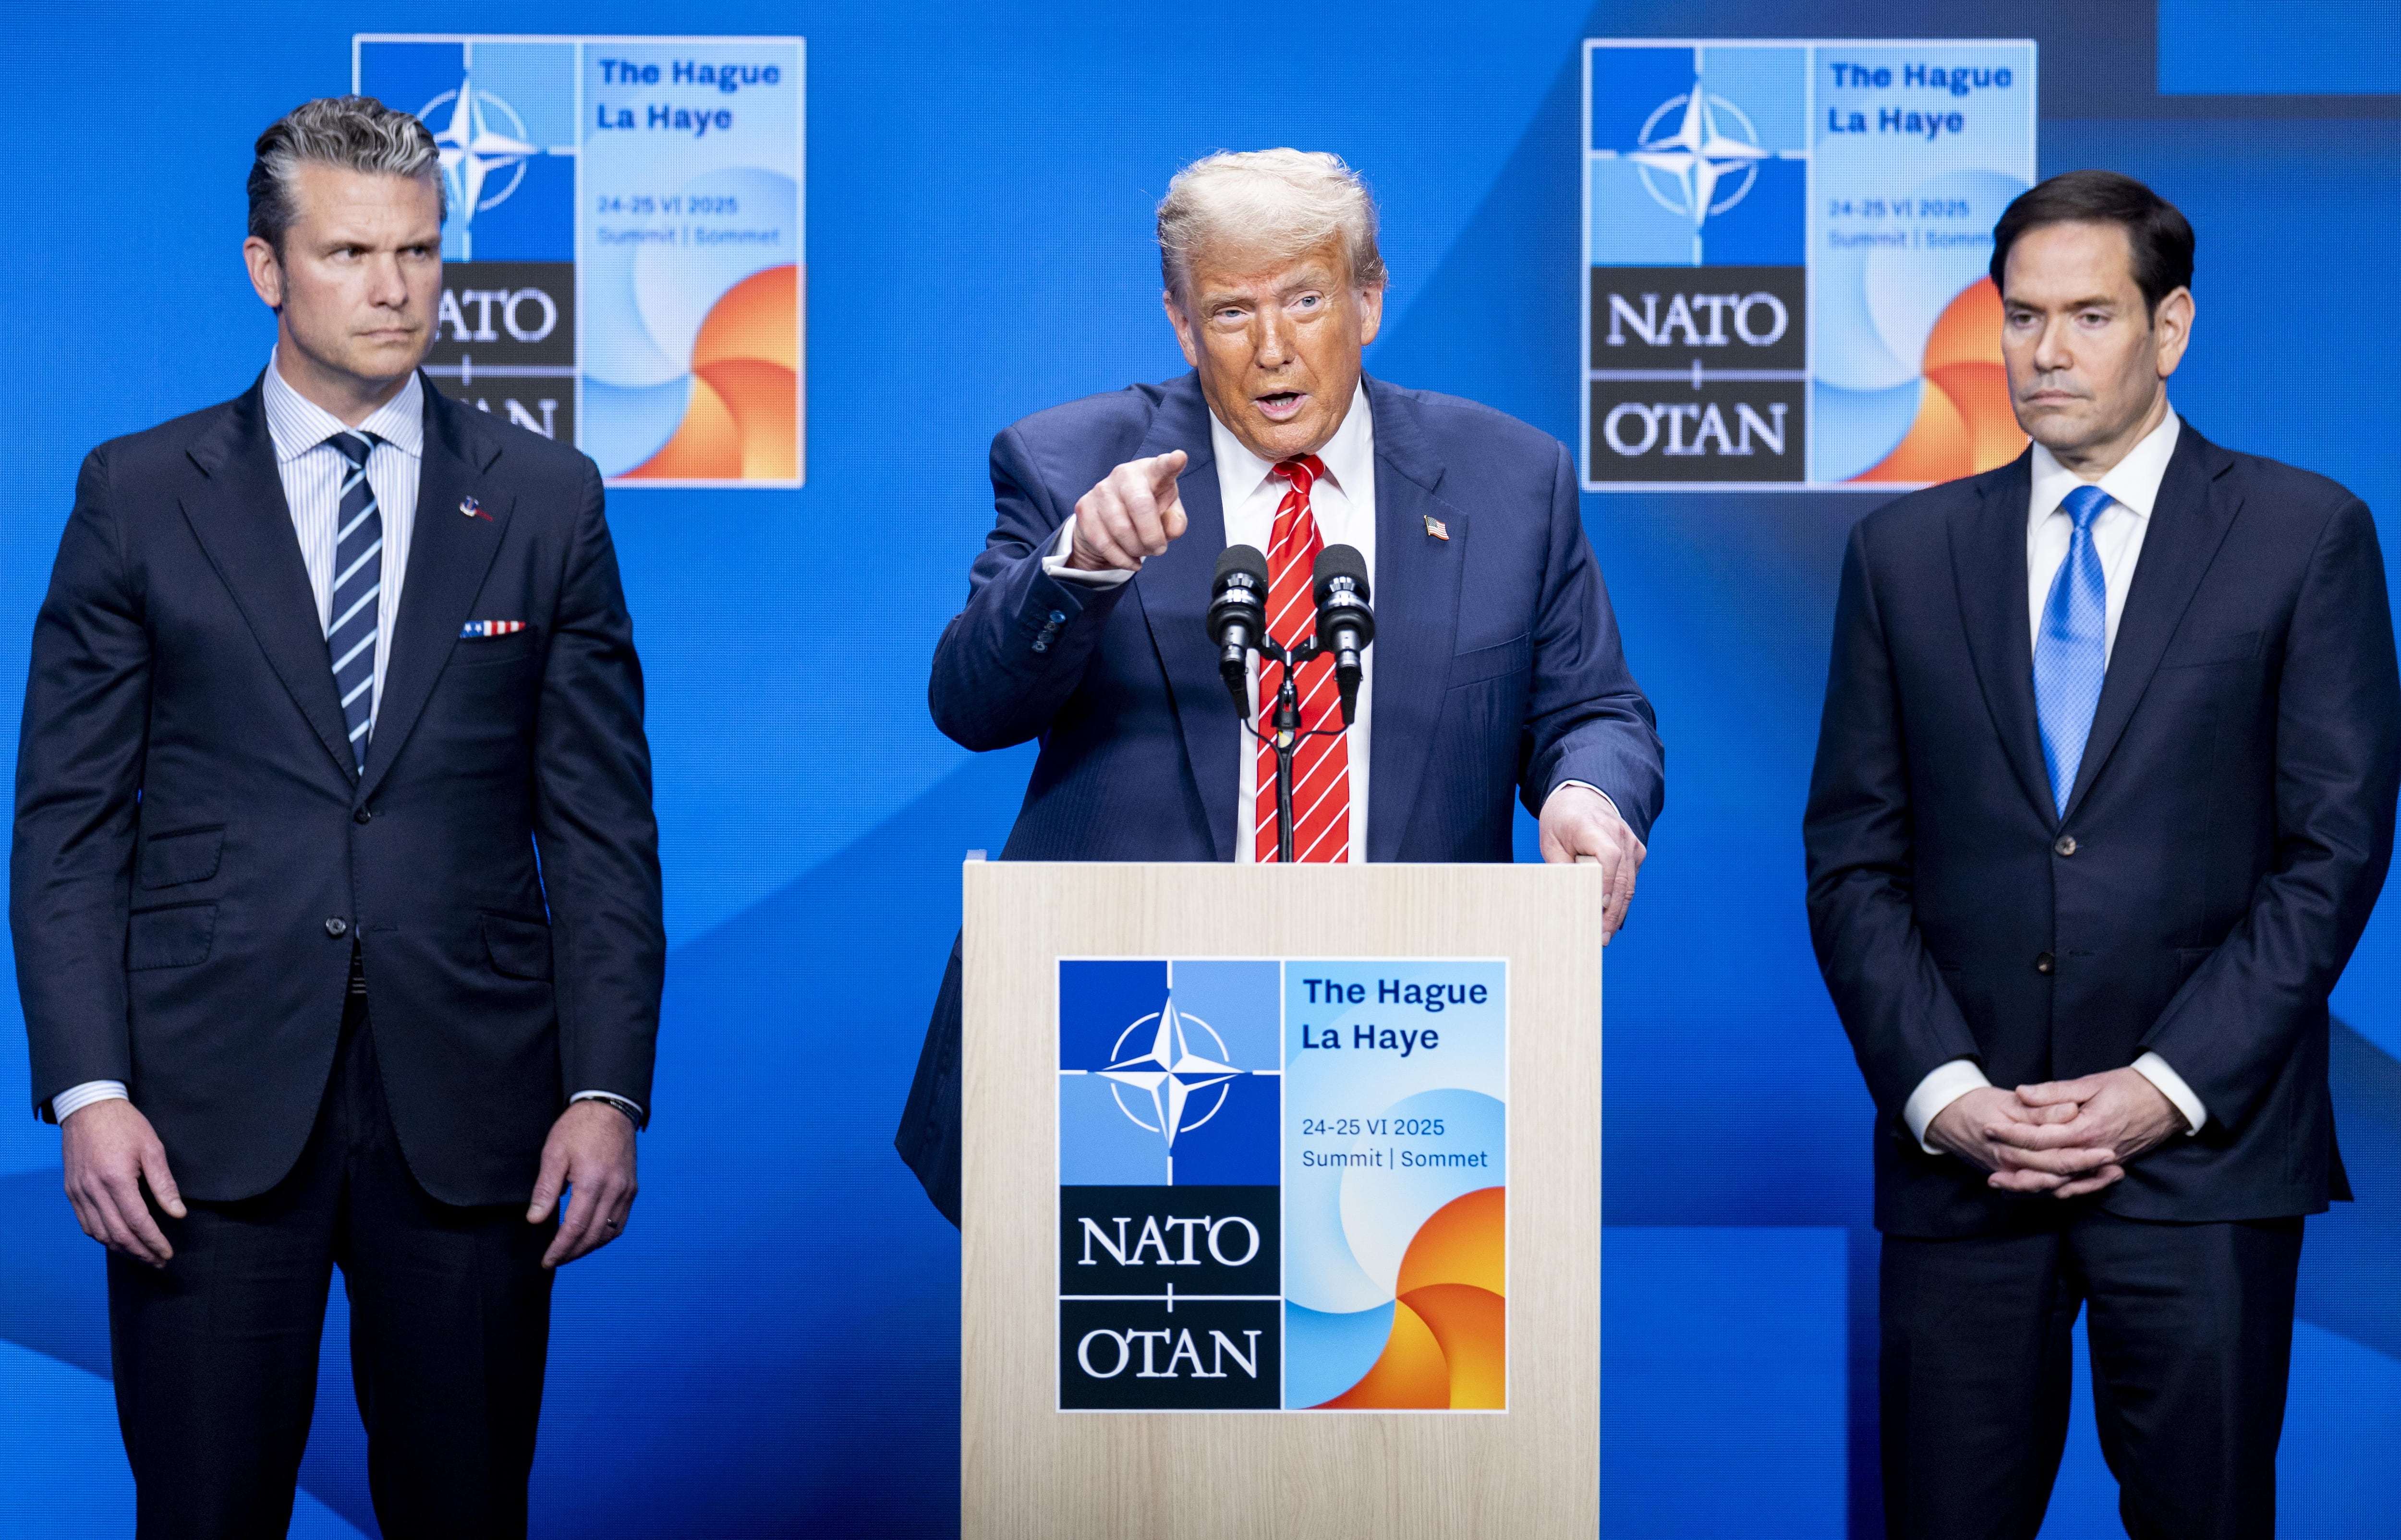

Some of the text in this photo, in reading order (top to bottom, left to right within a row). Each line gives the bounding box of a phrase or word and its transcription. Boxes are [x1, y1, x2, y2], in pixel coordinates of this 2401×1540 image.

[598, 60, 781, 93] The Hague
[1831, 63, 2013, 96] The Hague
[597, 105, 733, 137] La Haye
[1829, 108, 1964, 140] La Haye
[598, 196, 739, 215] 24-25 VI 2025
[1829, 199, 1969, 217] 24-25 VI 2025
[598, 227, 674, 245] Summit
[695, 227, 780, 245] Sommet
[1830, 229, 1907, 249] Summit
[1926, 229, 1994, 249] Somm
[434, 288, 558, 343] ATO
[1606, 292, 1789, 347] NATO
[1603, 403, 1788, 456] OTAN
[1302, 978, 1488, 1013] The Hague
[1302, 1024, 1440, 1058] La Haye
[1302, 1119, 1445, 1135] 24-25 VI 2025
[1302, 1148, 1383, 1167] Summit
[1401, 1151, 1488, 1167] Sommet
[1078, 1215, 1260, 1266] NATO
[1077, 1328, 1262, 1379] OTAN
